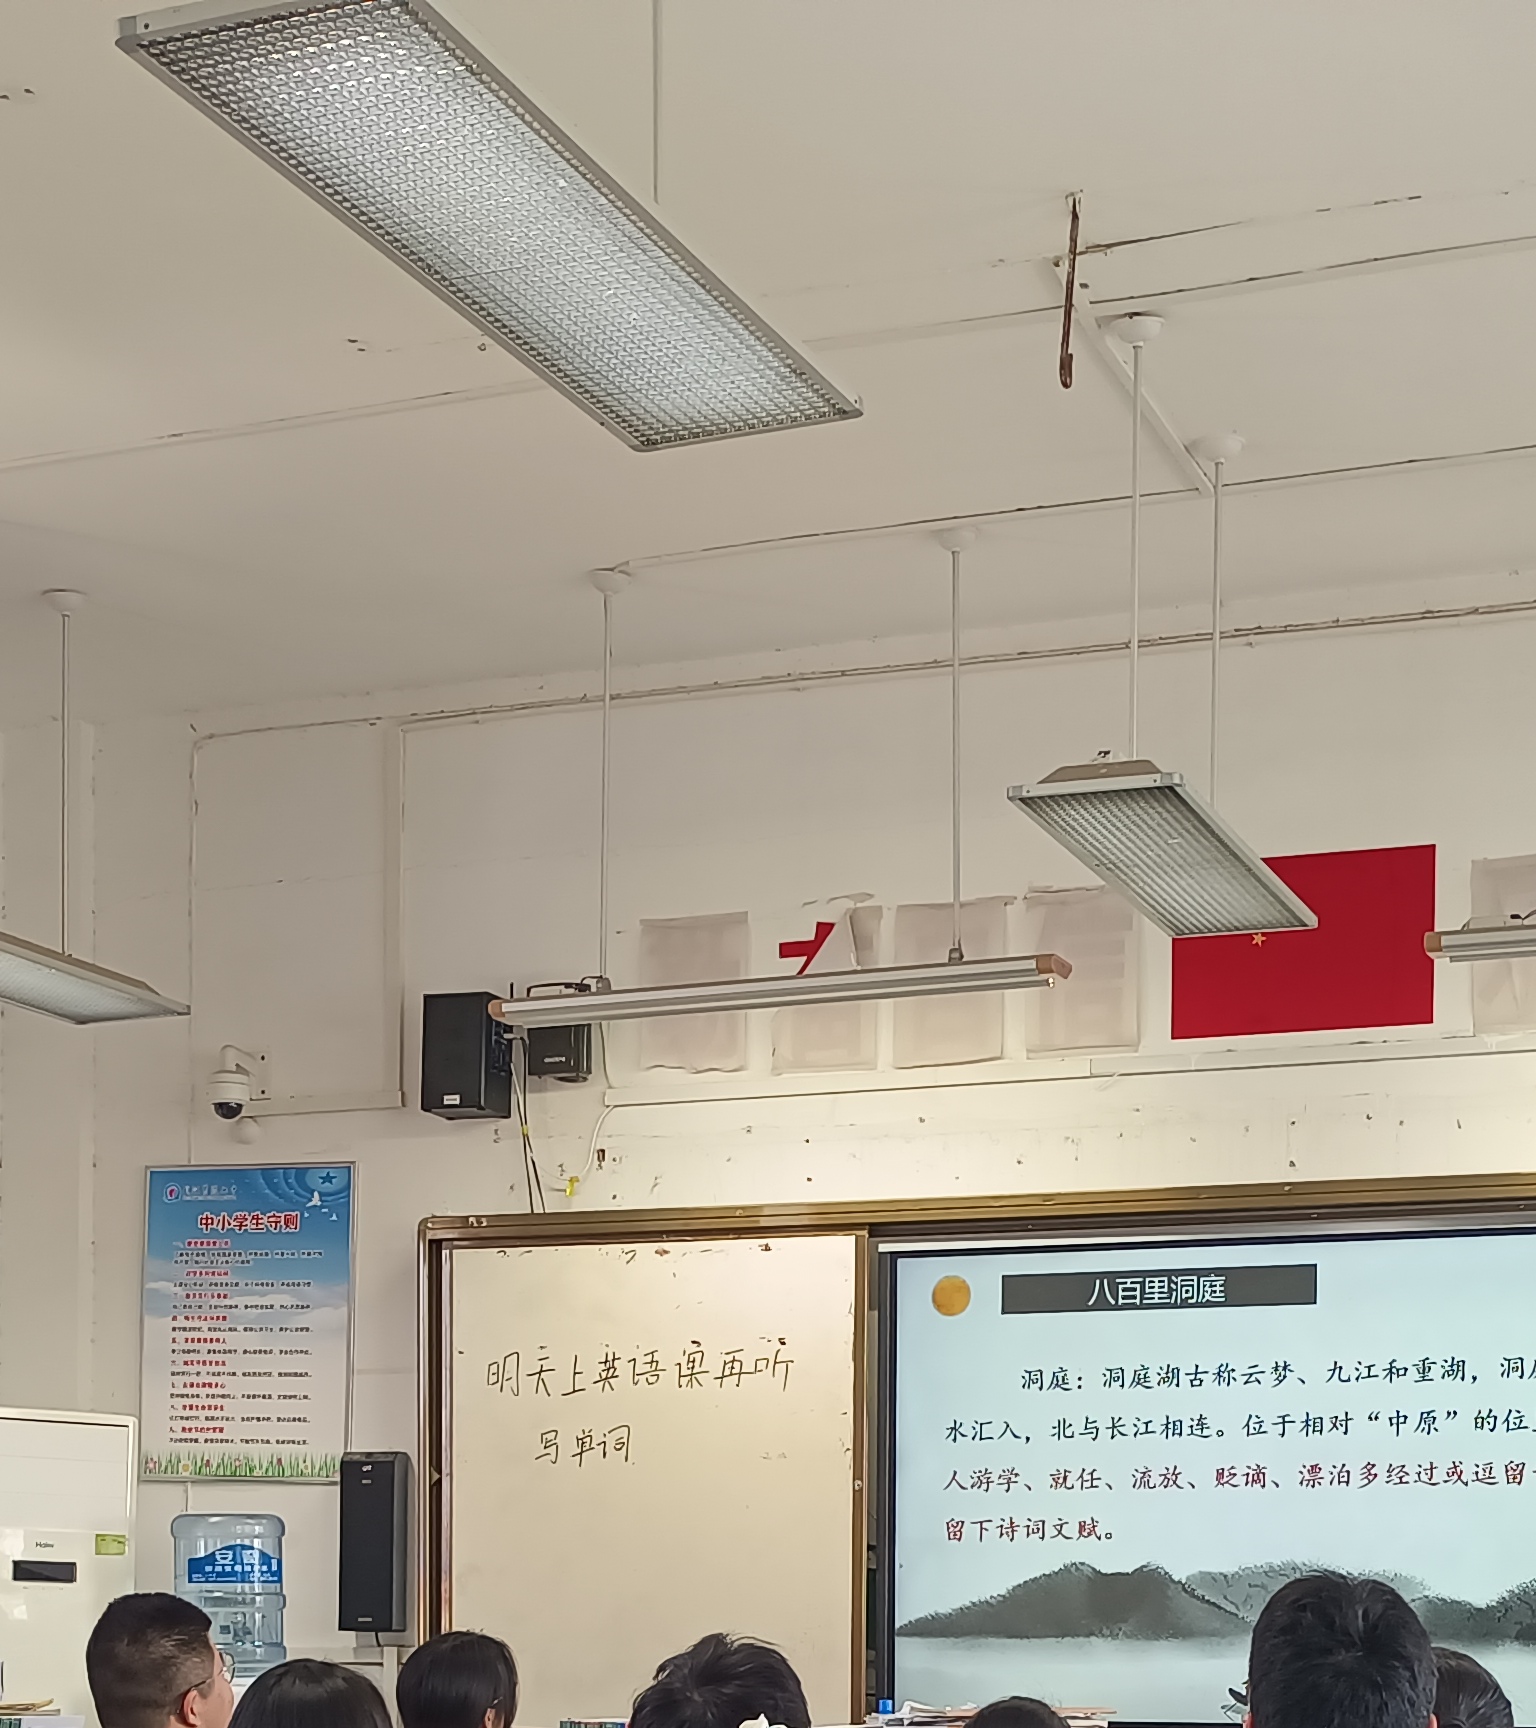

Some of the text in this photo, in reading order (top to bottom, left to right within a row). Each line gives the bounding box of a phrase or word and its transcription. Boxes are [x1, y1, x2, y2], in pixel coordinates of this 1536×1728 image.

[199, 1212, 300, 1233] 中小学生守则
[1087, 1274, 1227, 1307] 八百里洞庭
[487, 1348, 795, 1397] 明天上英语课再听
[943, 1515, 1117, 1544] 留下诗词文赋。
